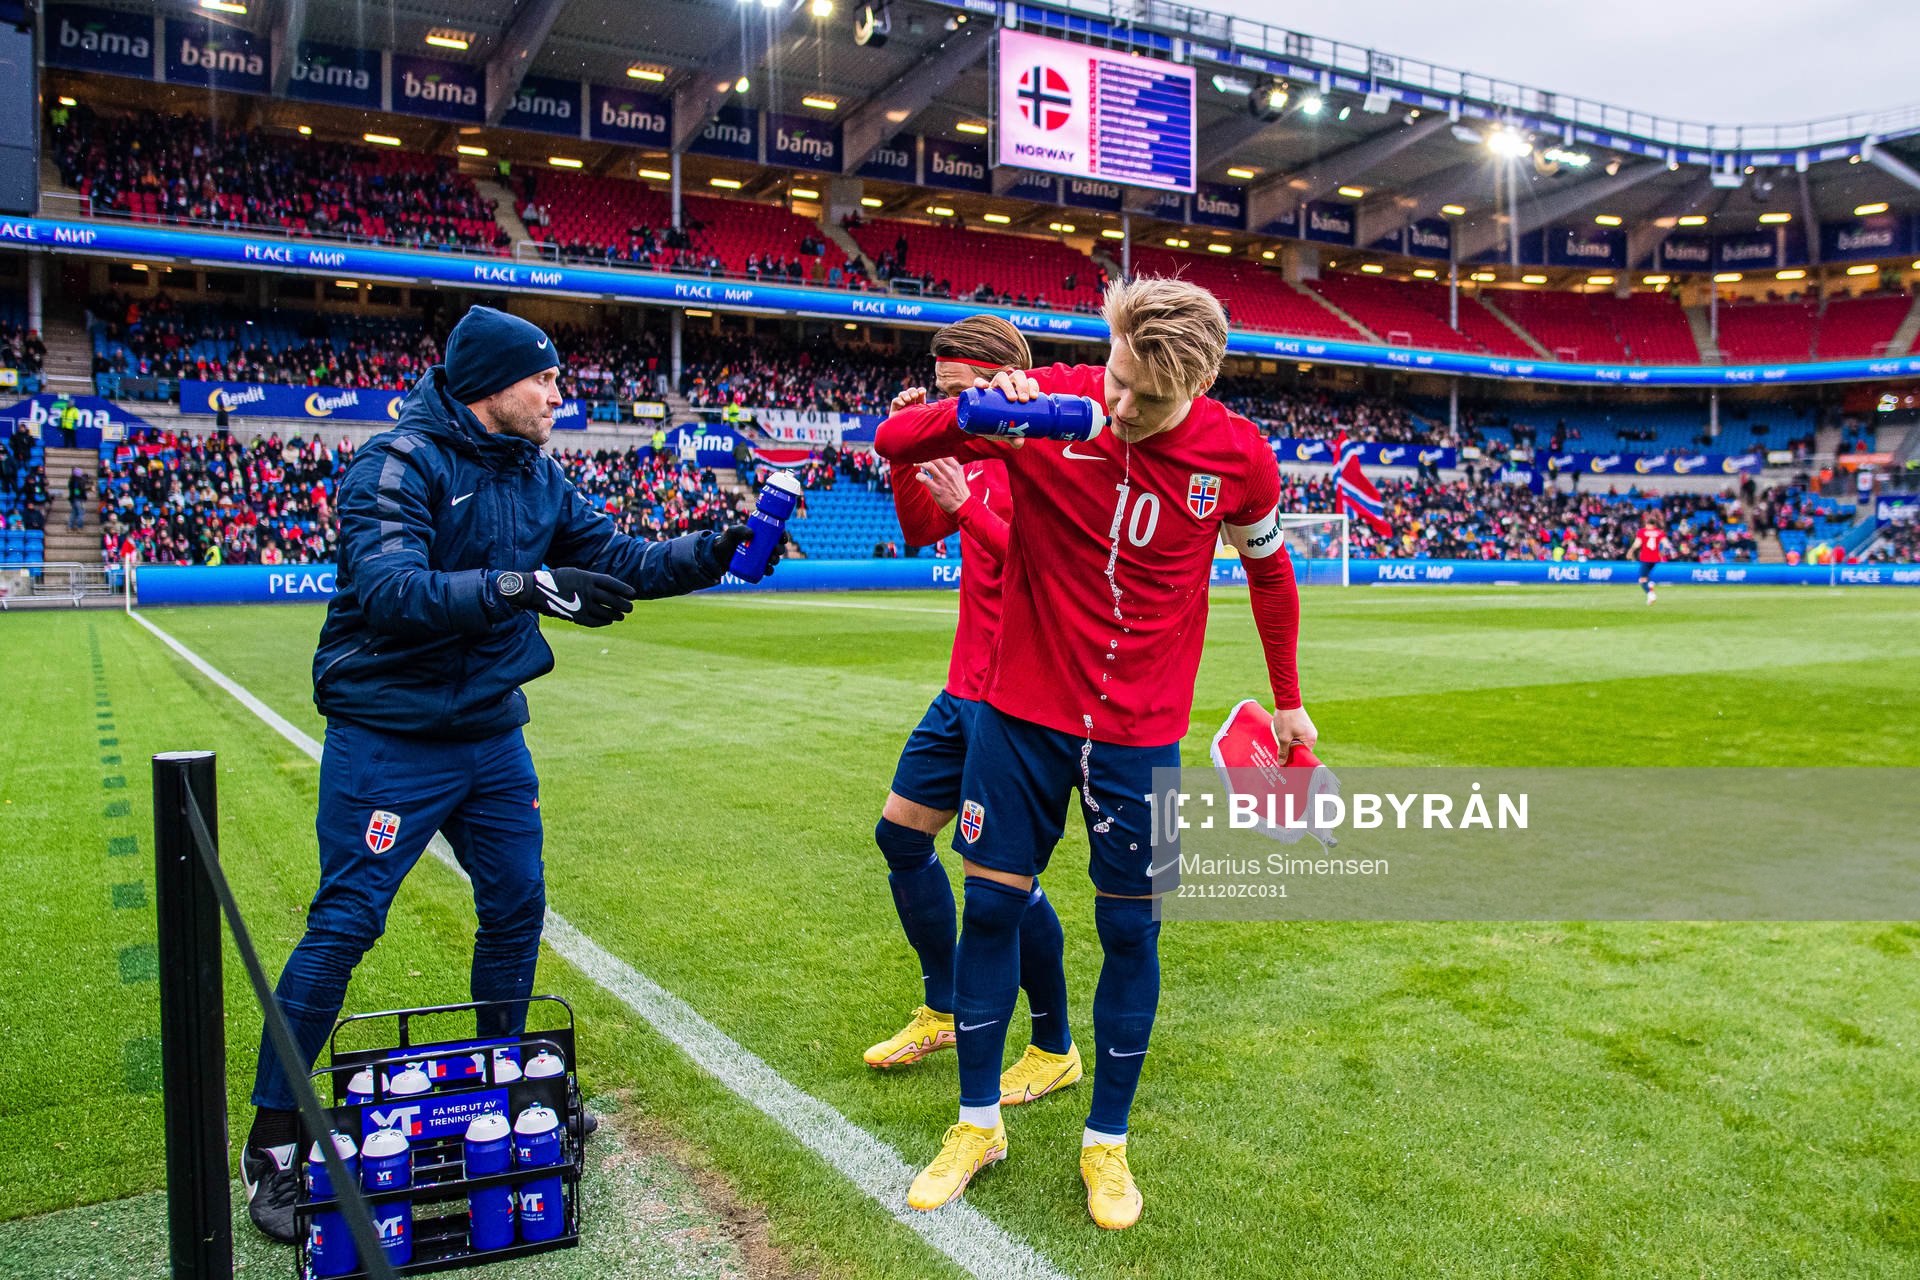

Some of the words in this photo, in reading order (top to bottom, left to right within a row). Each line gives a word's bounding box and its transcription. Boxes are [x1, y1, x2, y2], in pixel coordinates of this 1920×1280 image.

[60, 20, 149, 59] bama
[181, 39, 264, 76] bama
[291, 55, 370, 90] bama
[404, 72, 477, 106] bama
[504, 94, 572, 119] ama
[602, 101, 666, 133] bama
[704, 123, 750, 145] ama
[777, 128, 834, 158] bama
[1016, 144, 1075, 162] NORWAY
[932, 152, 984, 179] bama
[1198, 194, 1240, 217] bama
[0, 222, 37, 240] ACE
[244, 239, 294, 262] PEACE
[474, 264, 518, 283] PEACE
[675, 283, 713, 298] PEACE
[852, 300, 886, 314] PEACE
[1010, 314, 1040, 327] PEACE
[221, 386, 265, 407] Bendit
[317, 390, 358, 411] Bendit
[678, 429, 734, 452] bama
[1109, 483, 1160, 547] 10
[1247, 525, 1279, 548] #ONE
[269, 573, 339, 594] PEAC
[933, 566, 962, 581] PEA
[1379, 565, 1416, 579] PEACE
[1548, 566, 1580, 580] PEACE
[1144, 788, 1179, 847] 10
[447, 1104, 467, 1115] MER
[469, 1102, 481, 1111] UT
[483, 1100, 497, 1109] AV
[372, 1215, 403, 1239] YT
